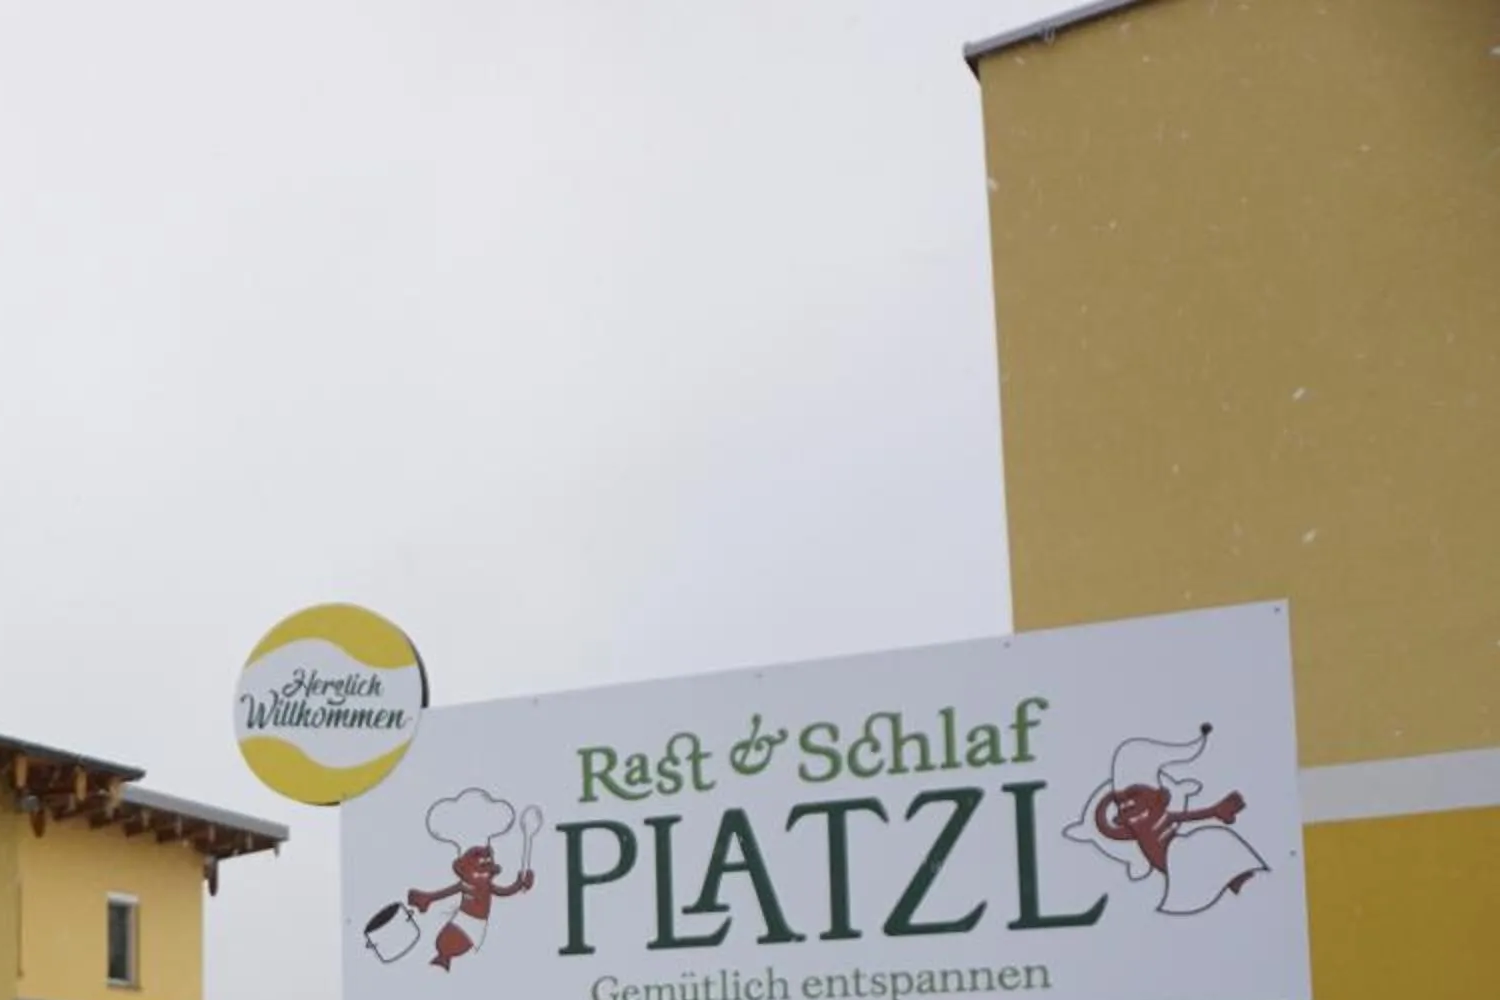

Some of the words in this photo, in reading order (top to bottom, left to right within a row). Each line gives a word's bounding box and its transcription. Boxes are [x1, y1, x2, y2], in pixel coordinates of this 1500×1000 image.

[240, 689, 413, 729] Willkommen
[282, 667, 383, 706] Herzlich
[577, 732, 717, 802] Rast
[729, 714, 788, 775] &
[799, 697, 1049, 782] Schlaf
[556, 780, 1109, 956] PLATZL
